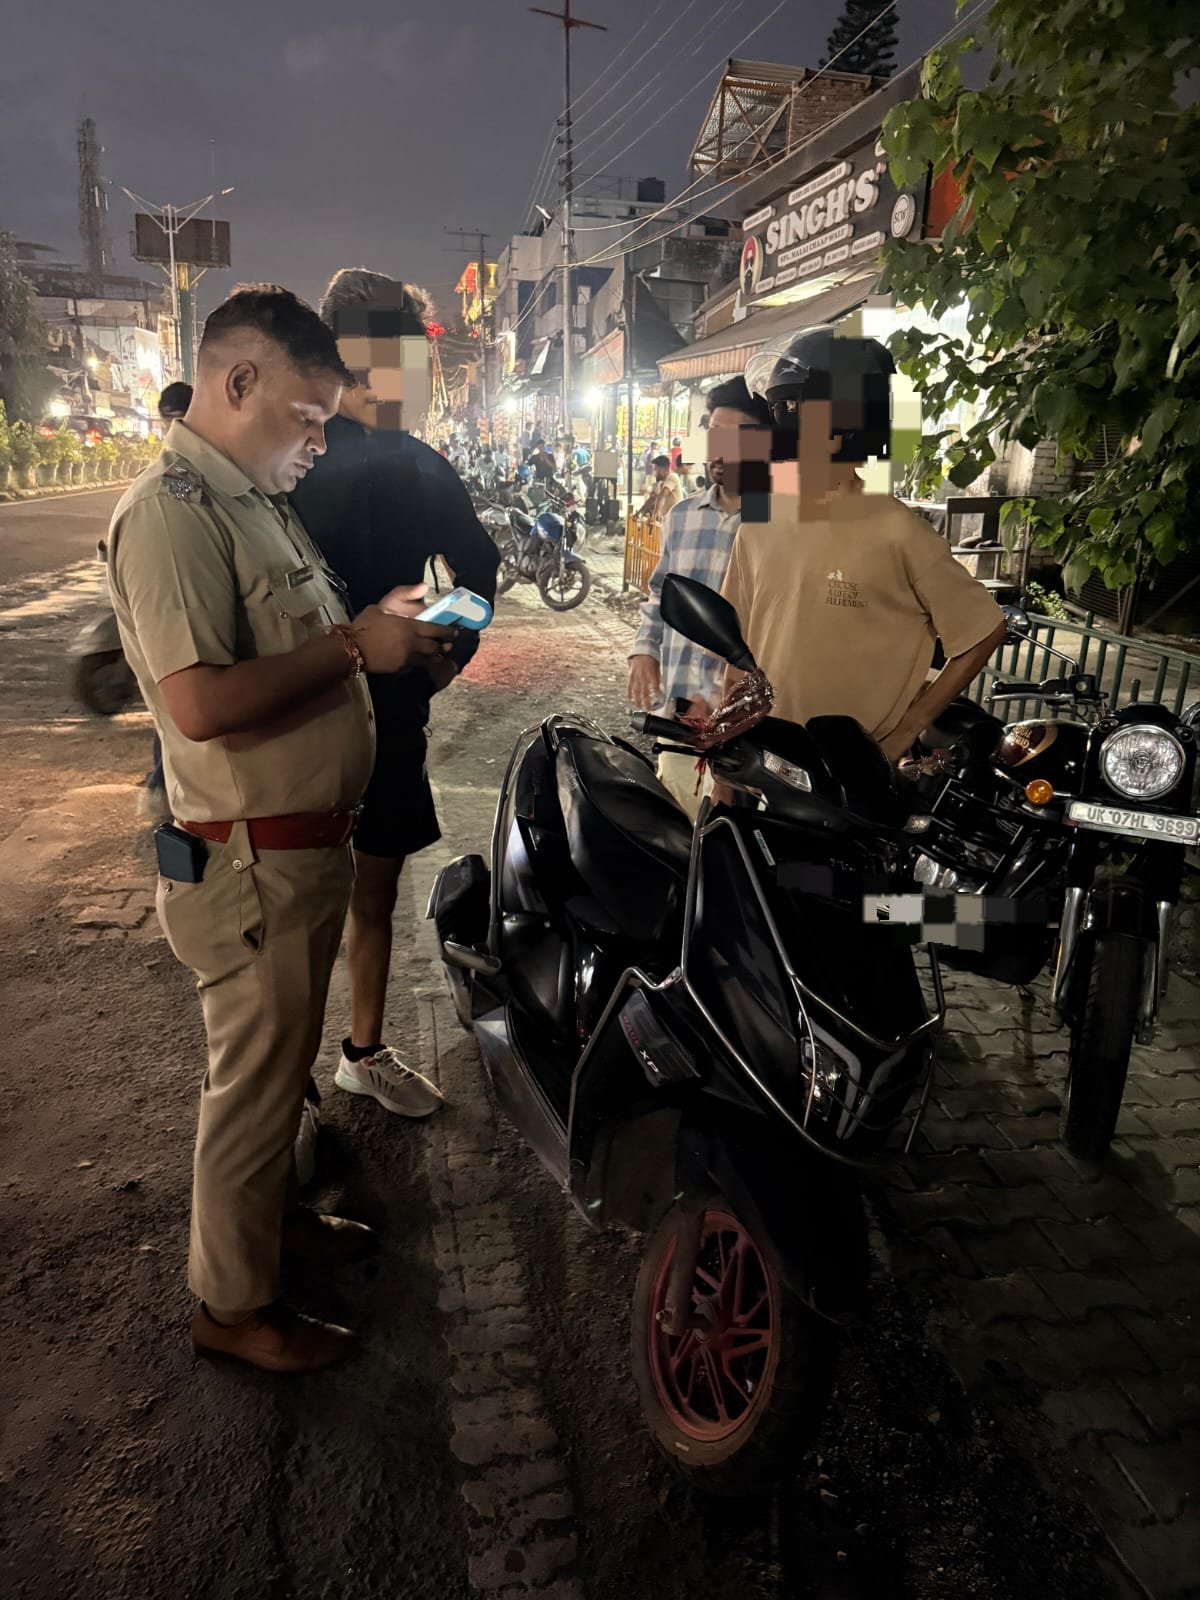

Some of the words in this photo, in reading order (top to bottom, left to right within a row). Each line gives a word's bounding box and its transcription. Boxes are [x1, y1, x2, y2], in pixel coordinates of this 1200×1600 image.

[766, 169, 876, 254] SINGH'S
[791, 244, 809, 259] MALAI
[809, 236, 829, 251] CHAAP
[1087, 807, 1105, 823] UK
[1111, 810, 1149, 829] 07HL
[1155, 817, 1196, 836] 9699
[639, 1049, 660, 1073] XP
